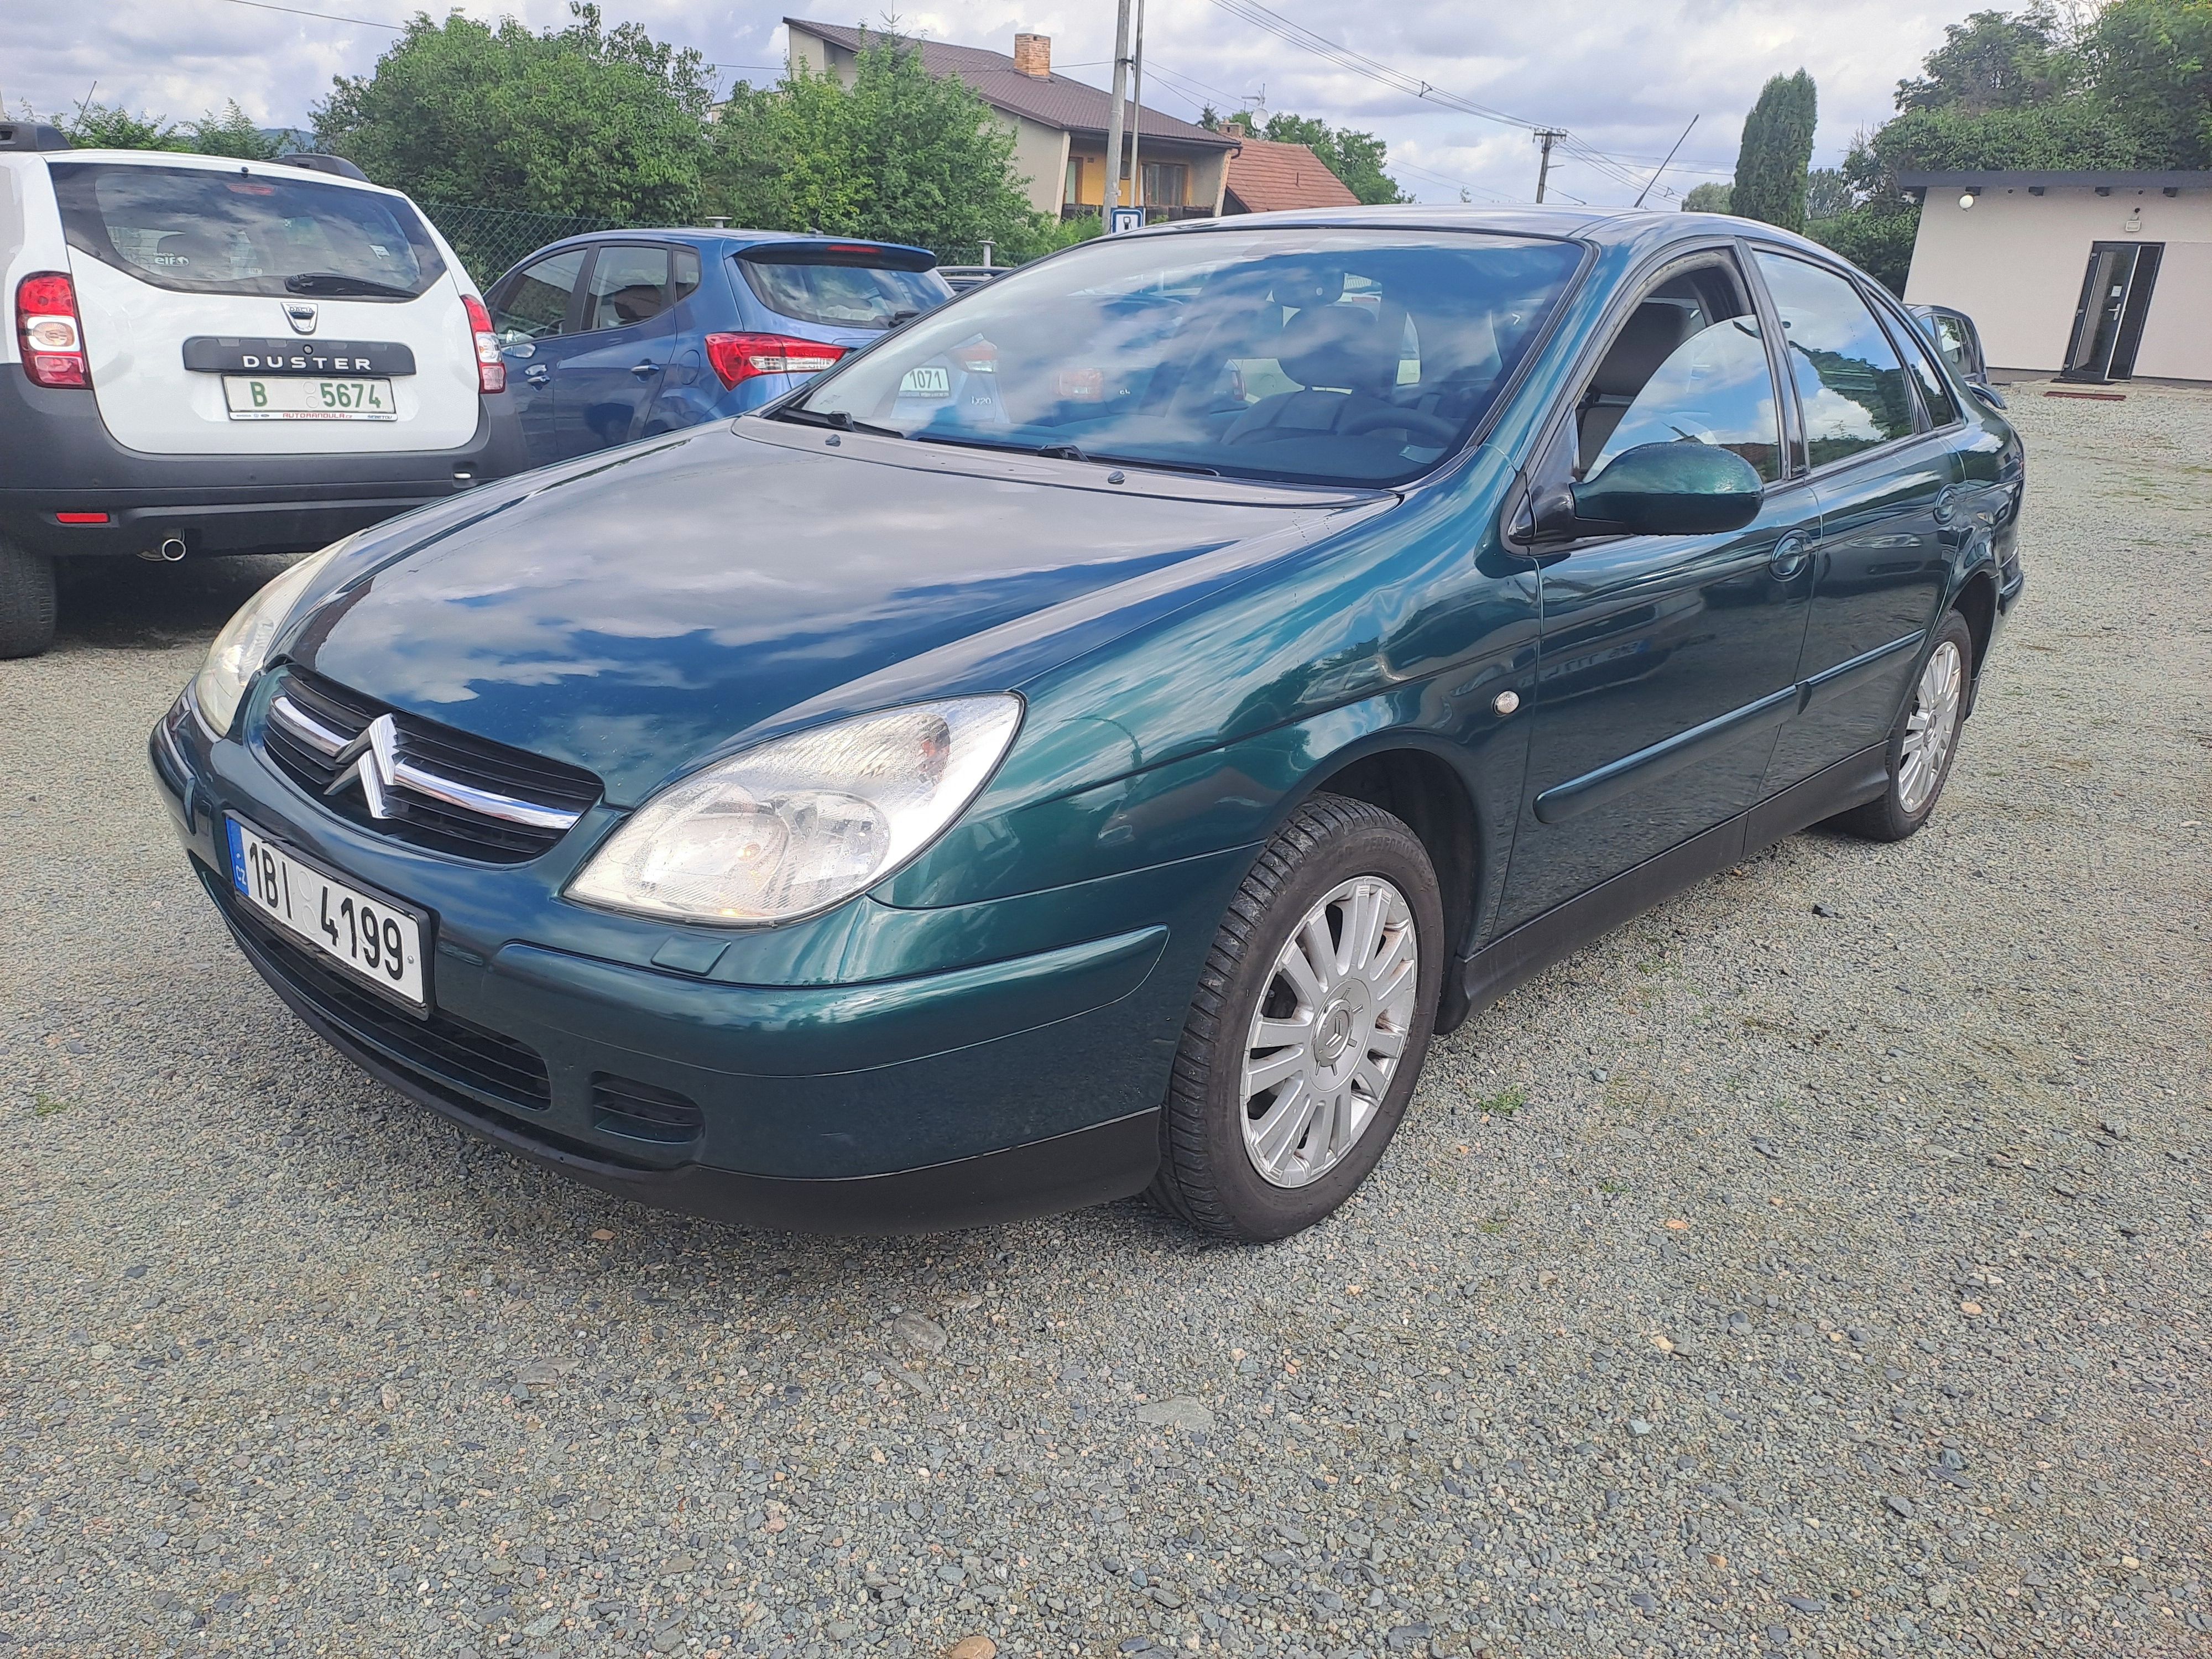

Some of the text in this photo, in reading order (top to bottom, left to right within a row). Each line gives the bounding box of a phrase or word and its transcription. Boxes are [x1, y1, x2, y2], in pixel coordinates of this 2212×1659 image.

[242, 356, 372, 371] DUSTER
[910, 370, 942, 389] 1071
[249, 382, 381, 408] B 5674
[235, 865, 247, 885] CZ
[250, 842, 404, 980] 1BI 4199
